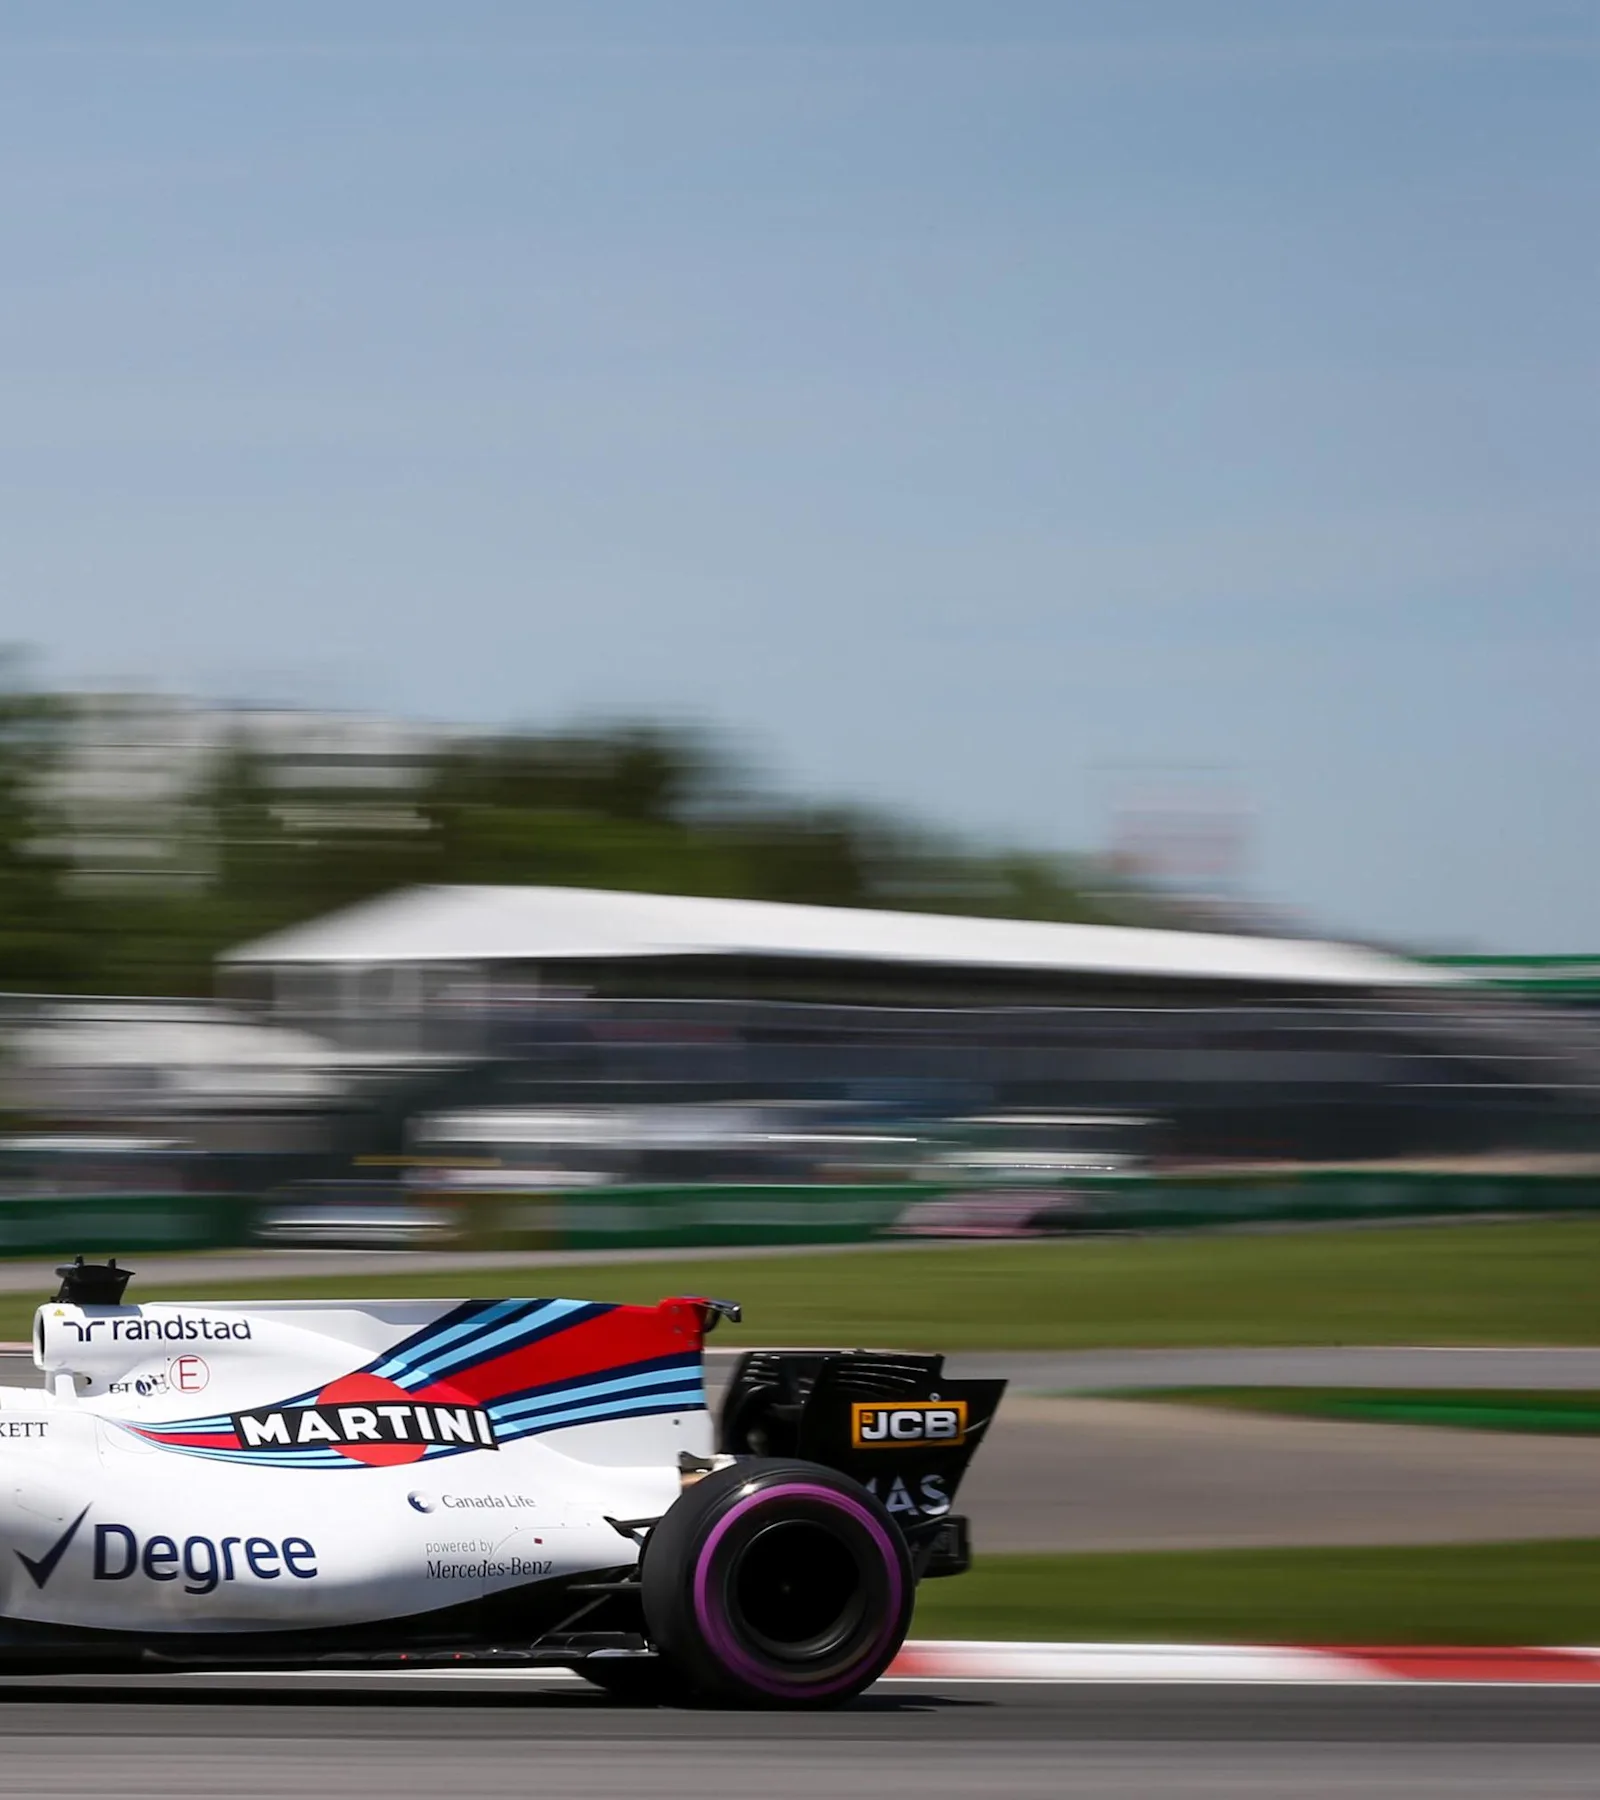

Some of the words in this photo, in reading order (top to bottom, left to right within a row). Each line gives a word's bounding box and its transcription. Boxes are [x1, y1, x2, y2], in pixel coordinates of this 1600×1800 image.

[113, 1314, 252, 1340] randstad
[179, 1359, 200, 1389] E
[237, 1404, 494, 1448] MARTINI
[861, 1411, 957, 1440] JCB
[442, 1494, 505, 1508] Canada
[504, 1494, 537, 1508] Life
[93, 1523, 319, 1595] Degree
[426, 1541, 476, 1556] powered
[480, 1540, 493, 1555] by
[426, 1557, 553, 1579] Mercedes-Benz
